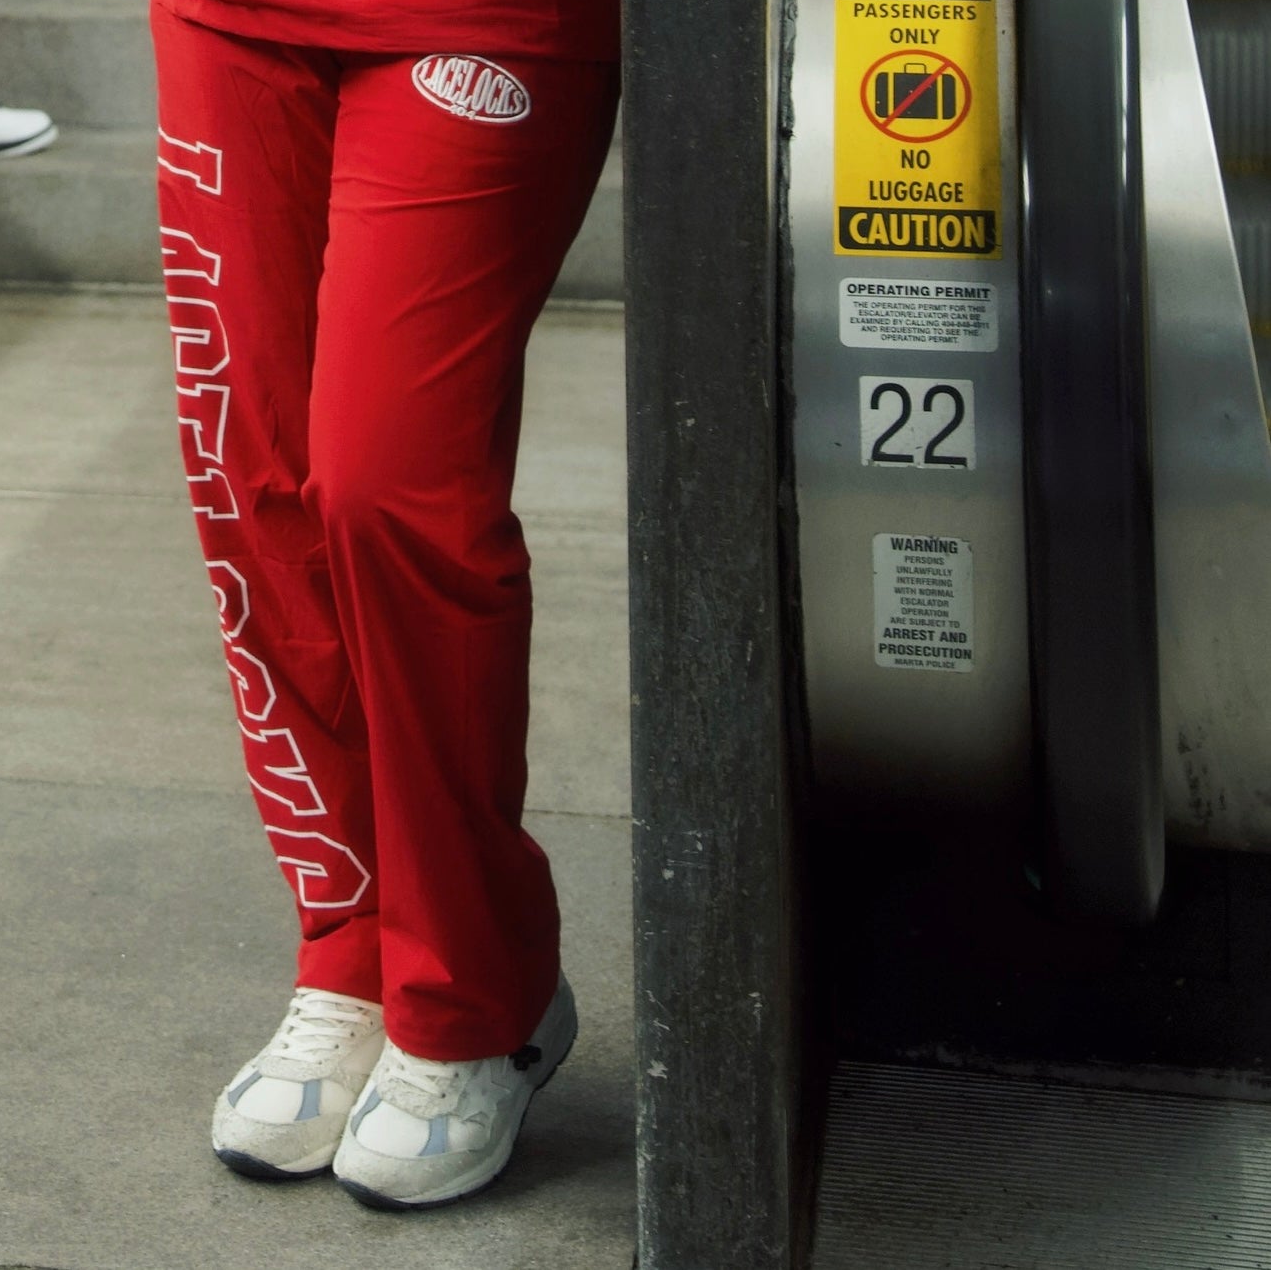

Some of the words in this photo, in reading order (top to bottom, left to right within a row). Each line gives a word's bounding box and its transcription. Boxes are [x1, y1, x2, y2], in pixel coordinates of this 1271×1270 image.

[853, 3, 977, 20] PASSENGERS
[890, 28, 940, 44] ONLY
[419, 57, 524, 115] LACELOCKS
[901, 149, 931, 169] NO
[869, 180, 964, 203] LUGGAGE
[848, 212, 986, 249] CAUTION
[847, 284, 930, 296] OPERATING
[936, 287, 991, 299] PERMIT
[853, 301, 868, 309] THE
[871, 302, 915, 310] OPERATING
[850, 317, 890, 325] EXAMINED
[905, 319, 939, 327] CALLING
[880, 326, 930, 335] REQUESTING
[946, 328, 960, 336] SEE
[881, 334, 926, 343] OPERATING
[870, 382, 968, 466] 22
[890, 537, 958, 554] WARNING
[904, 555, 945, 565] PERSONS
[896, 565, 953, 576] UNLAWFULLY
[896, 576, 953, 587] INTERFERING
[894, 587, 916, 595] WITH
[919, 588, 954, 598] NORMAL
[900, 597, 949, 607] ESCALATOR
[901, 607, 949, 617] OPERATION
[909, 618, 947, 627] SUBJECT
[949, 620, 960, 628] TO
[883, 627, 936, 641] ARREST
[939, 631, 967, 643] AND
[878, 643, 972, 659] PROSECUTION
[894, 658, 924, 667] MARTA
[926, 660, 955, 669] POLICE
